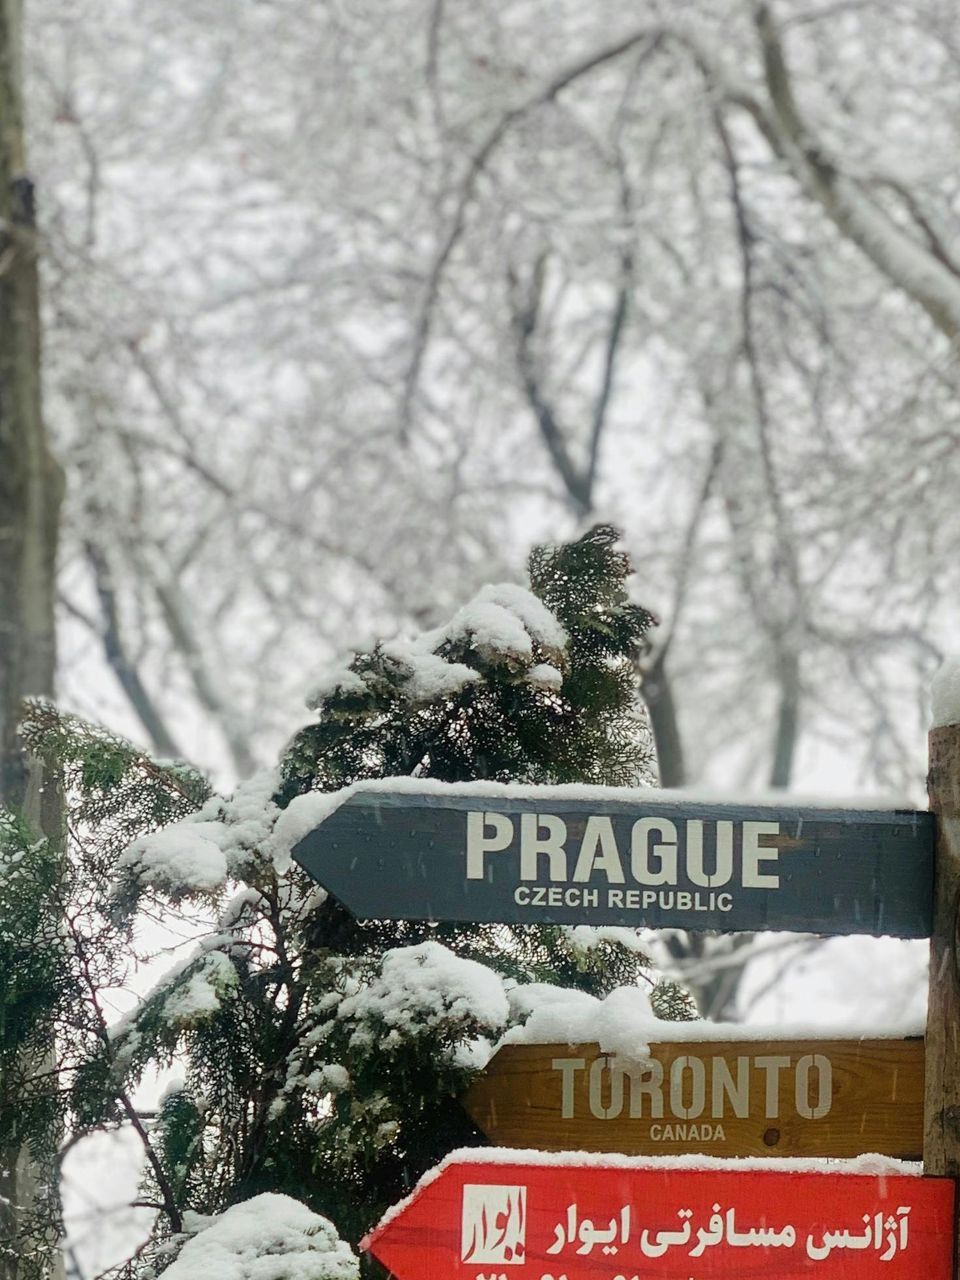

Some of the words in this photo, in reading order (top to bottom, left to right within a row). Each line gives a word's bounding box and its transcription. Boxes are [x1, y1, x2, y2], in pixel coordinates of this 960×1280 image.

[465, 811, 779, 889] PRAGUE
[514, 886, 598, 909] CZECH
[608, 888, 732, 912] REPUBLIC
[552, 1054, 832, 1120] TORONTO
[650, 1124, 726, 1142] CANADA
[546, 1203, 630, 1255] ایوار
[640, 1203, 796, 1258] مسافرتی
[806, 1206, 911, 1261] آژانس
